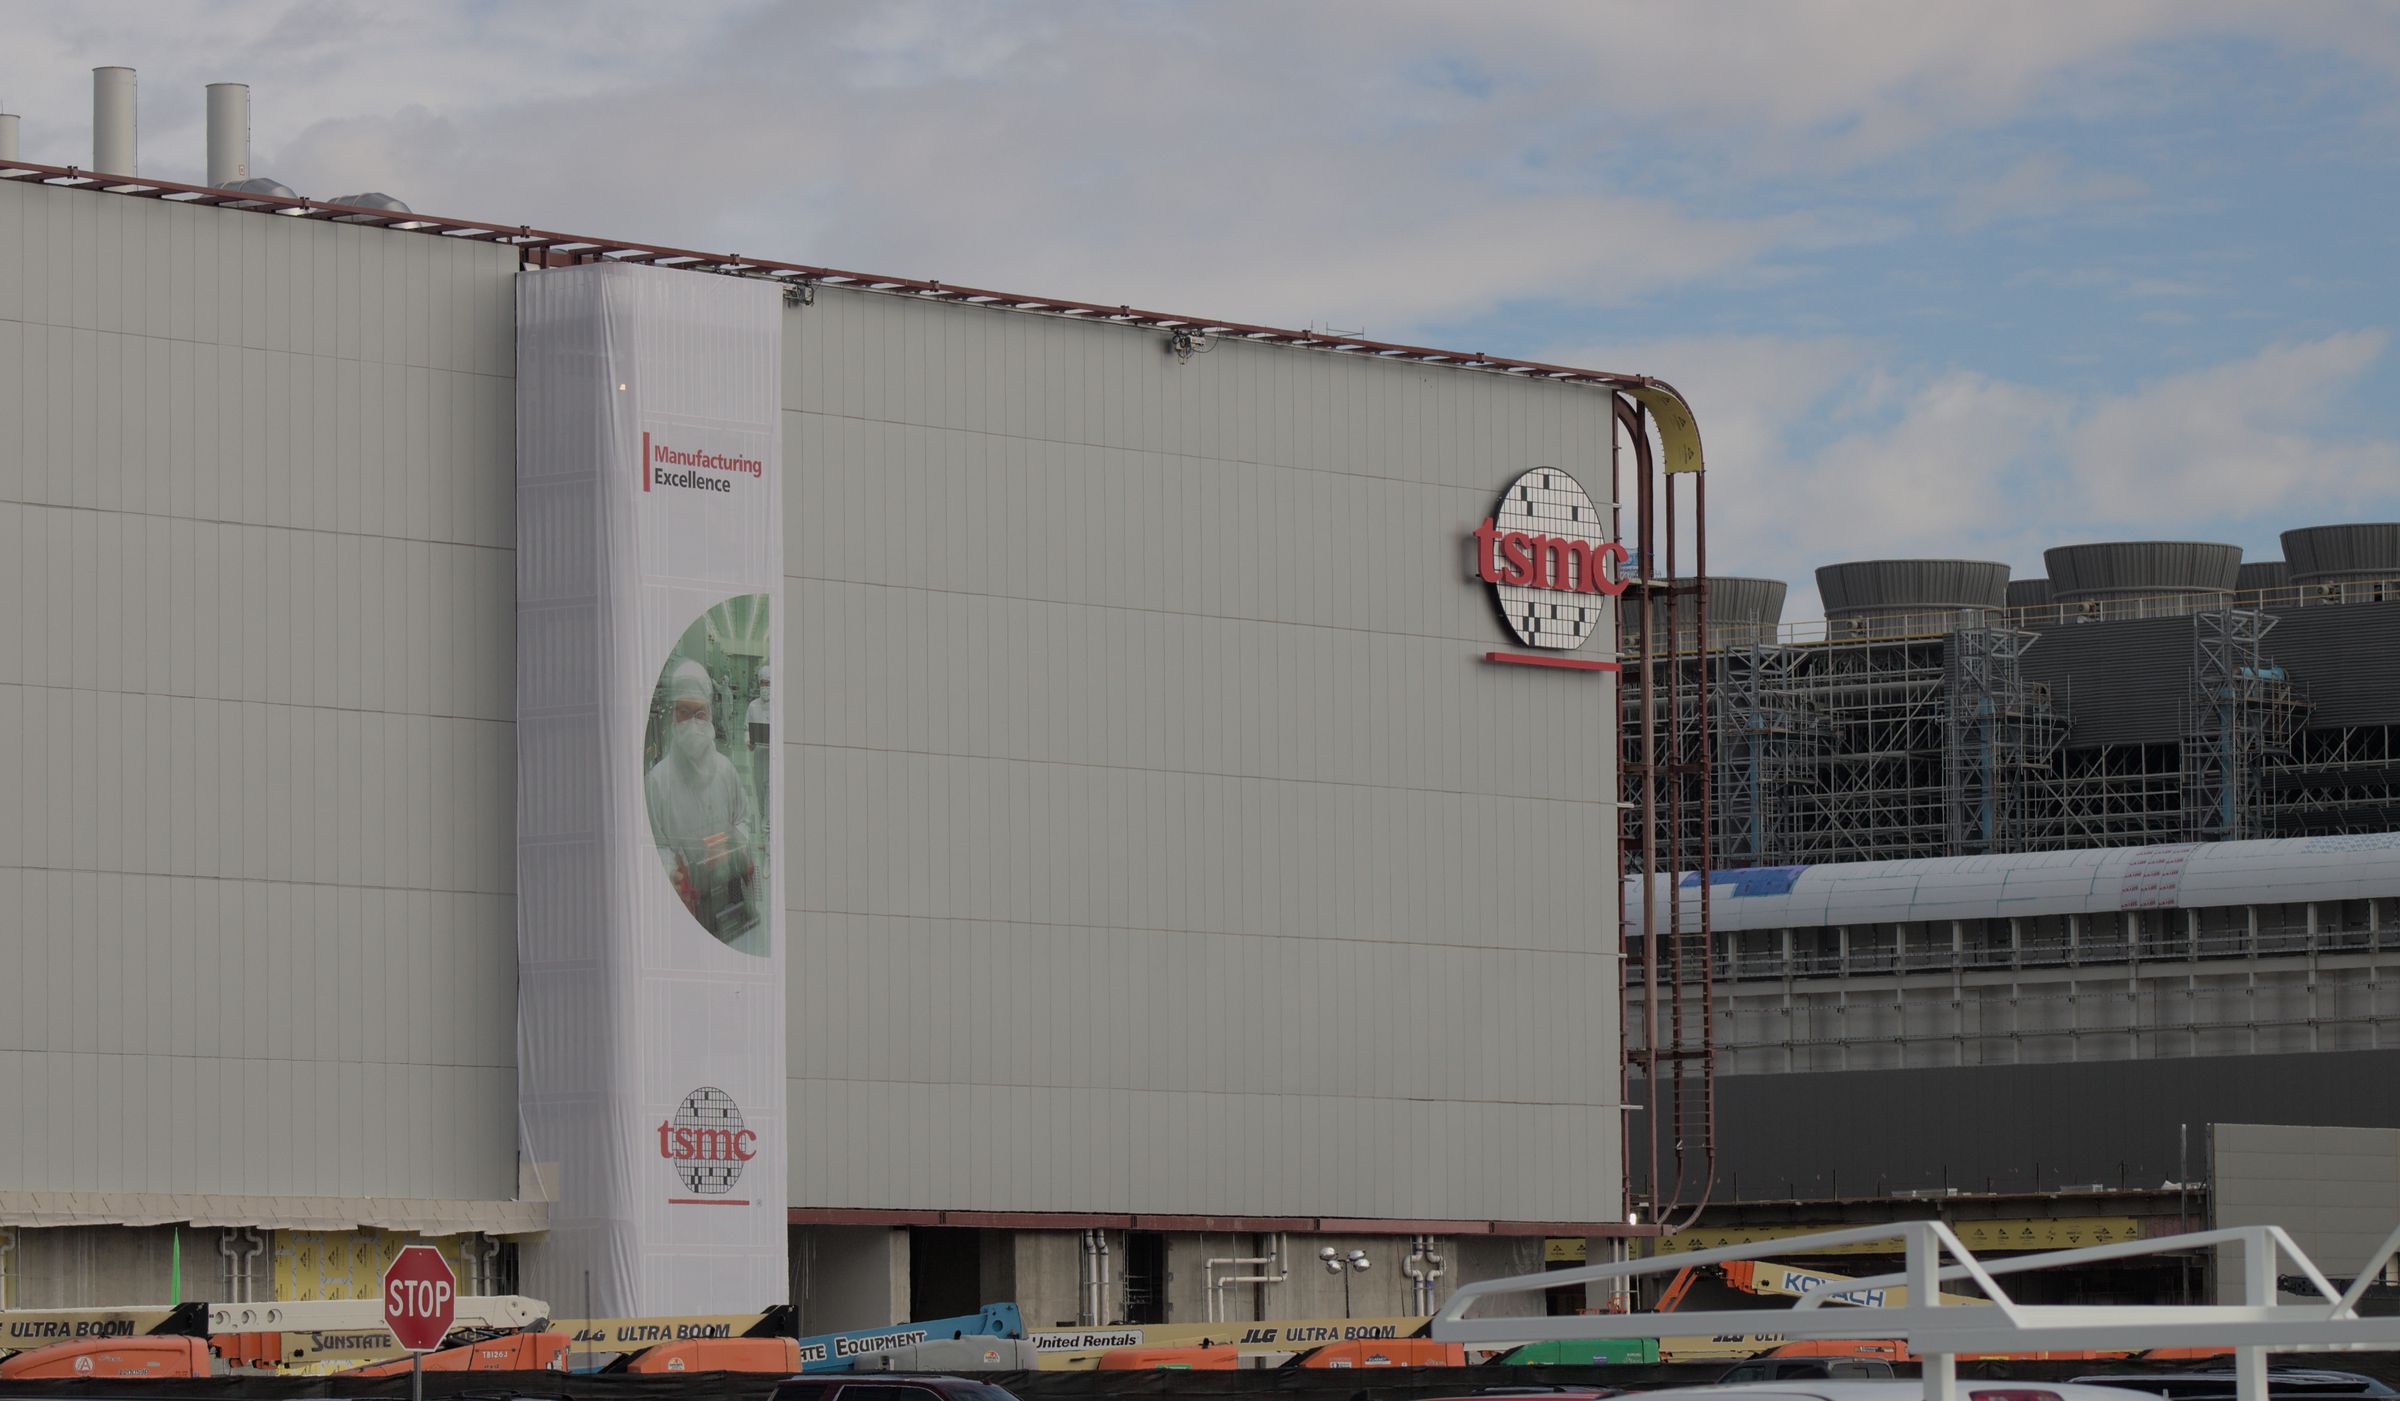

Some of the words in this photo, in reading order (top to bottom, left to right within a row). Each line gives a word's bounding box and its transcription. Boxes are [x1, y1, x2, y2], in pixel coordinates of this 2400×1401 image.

[654, 445, 762, 478] Manufacturing
[654, 468, 731, 493] Excellence
[1473, 516, 1630, 596] tsmc
[657, 1120, 757, 1162] tsmc
[388, 1279, 451, 1318] STOP
[10, 1321, 72, 1338] ULTRA
[75, 1320, 135, 1337] BOOM
[572, 1329, 606, 1342] JLG
[616, 1325, 672, 1342] ULTRA
[676, 1323, 730, 1339] BOOM
[1032, 1335, 1080, 1349] United
[1083, 1333, 1136, 1347] Rentals
[1240, 1329, 1278, 1343] JLG
[1286, 1326, 1339, 1342] ULTRA
[1344, 1325, 1396, 1339] BOOM
